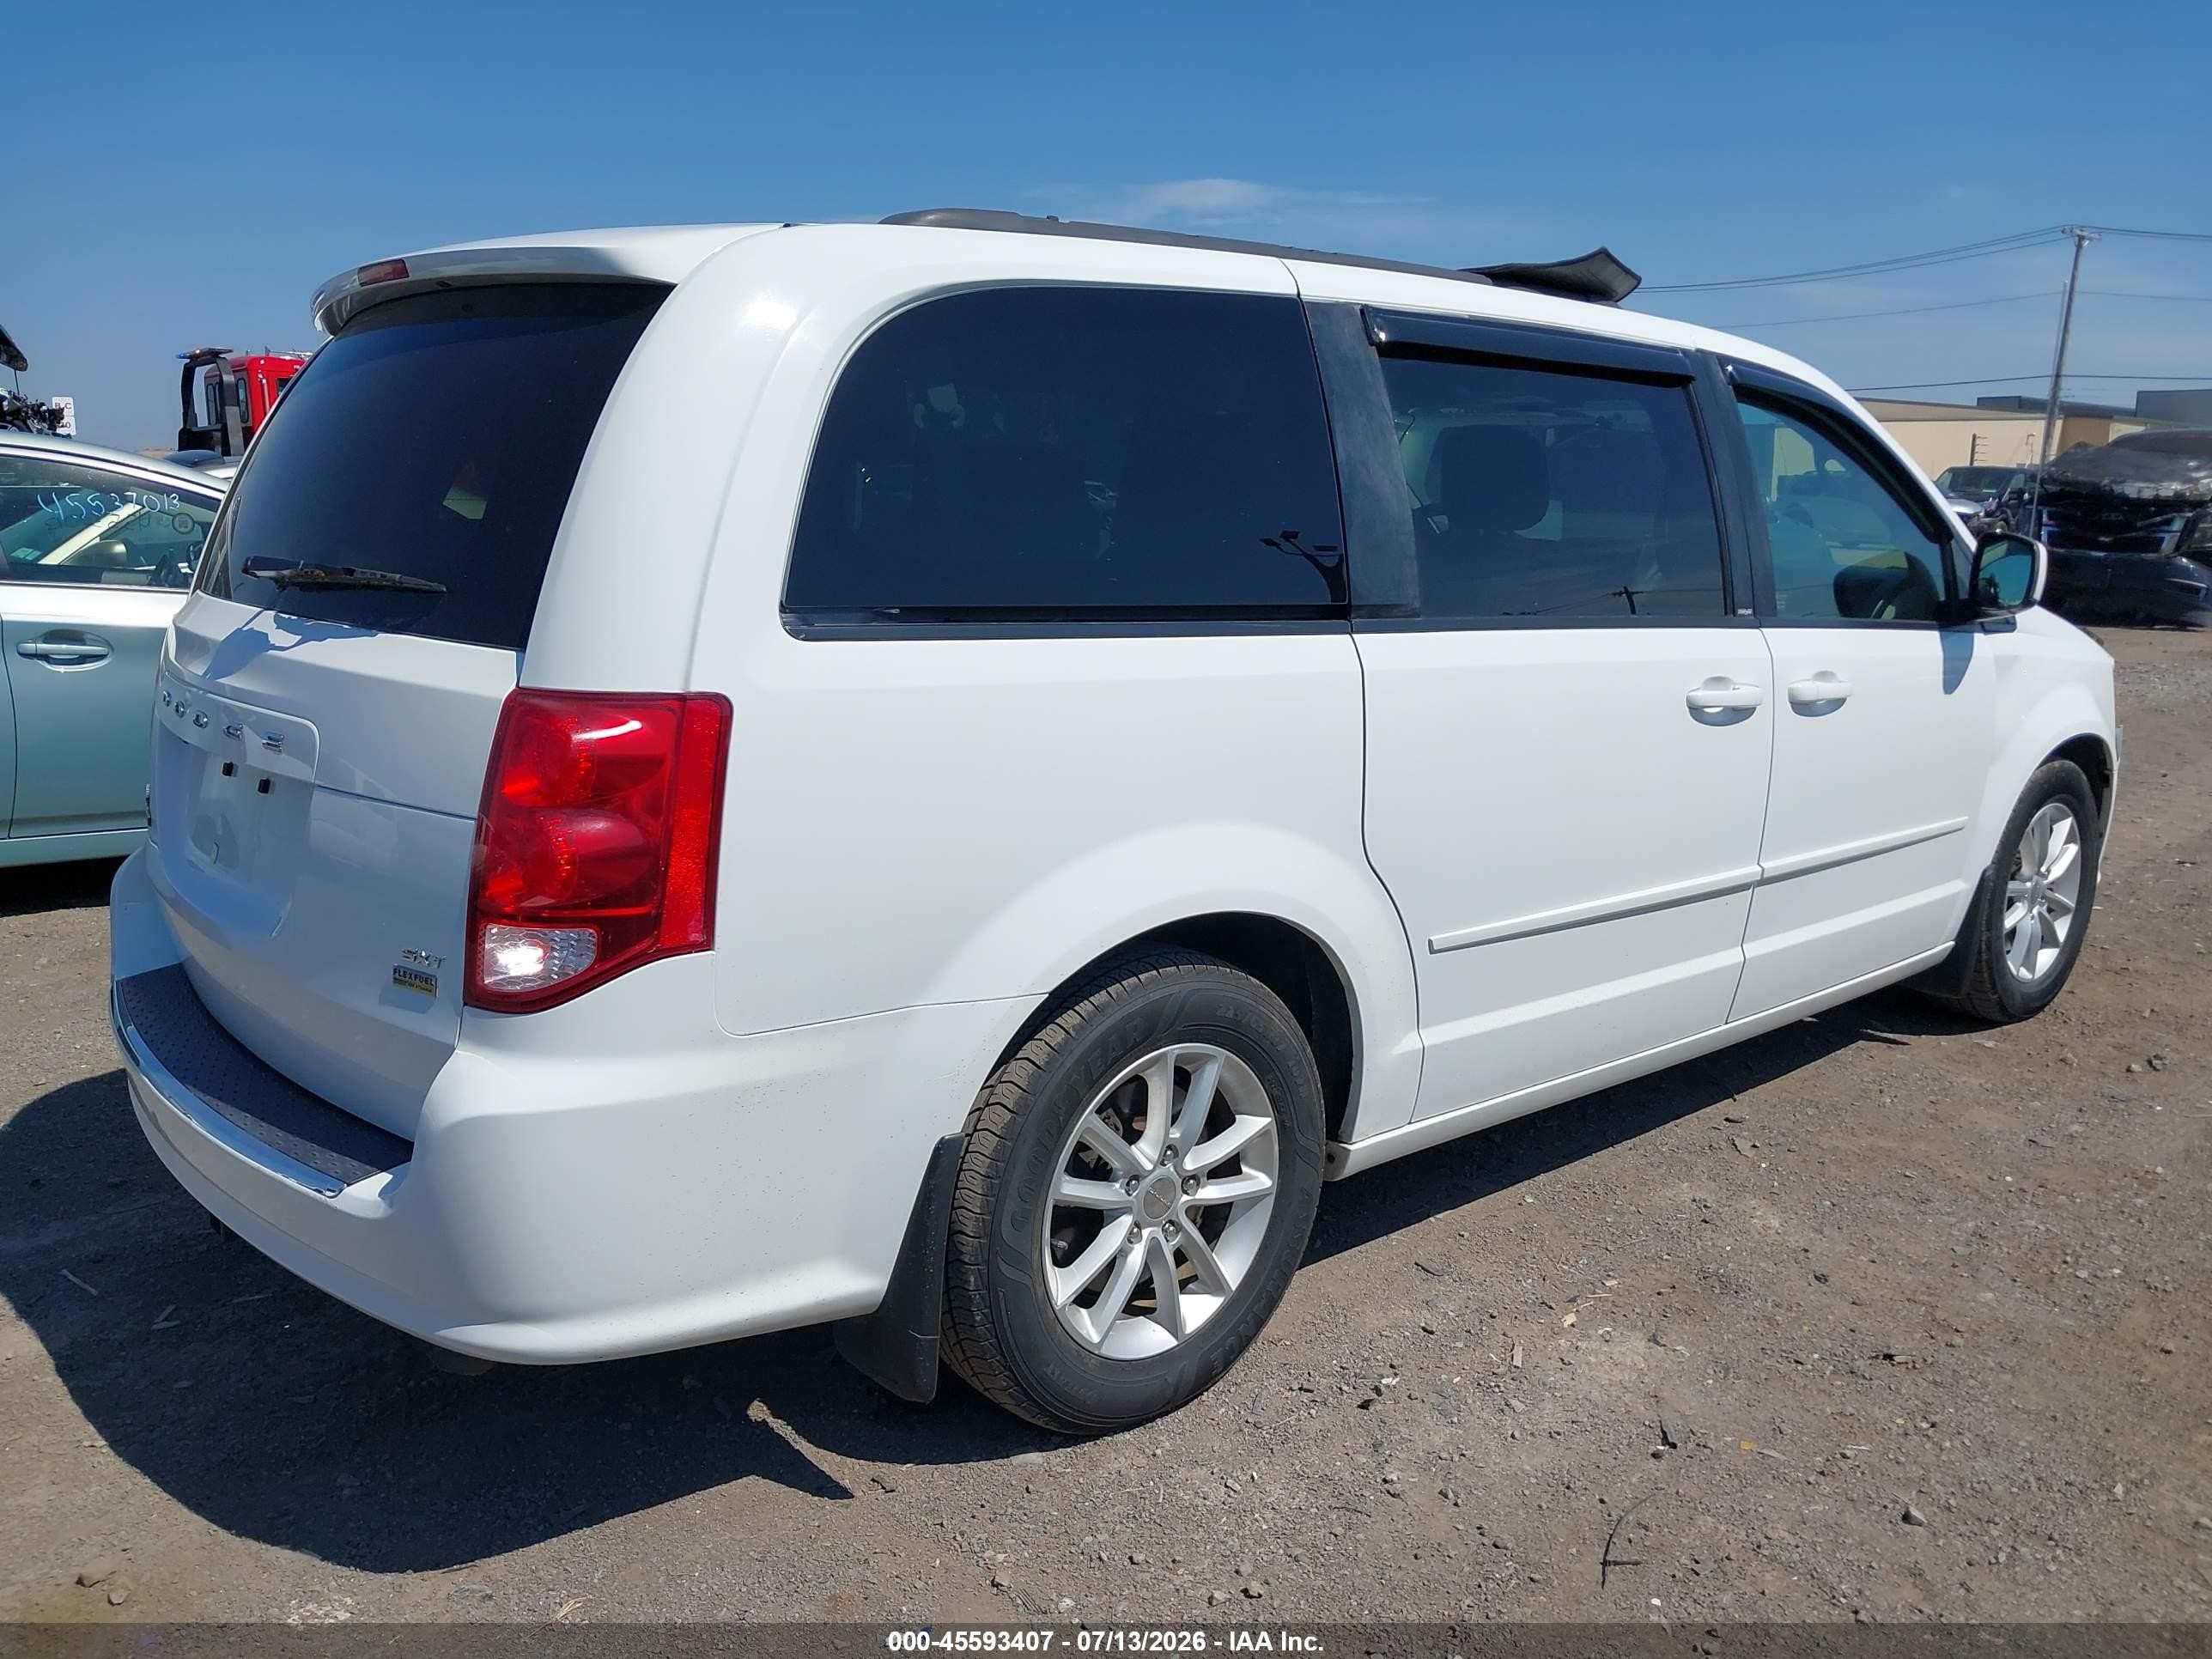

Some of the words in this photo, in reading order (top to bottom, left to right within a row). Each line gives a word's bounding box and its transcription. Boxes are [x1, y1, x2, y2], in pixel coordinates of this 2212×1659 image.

[37, 491, 180, 521] 45537013
[162, 690, 285, 755] DODGE
[401, 948, 447, 969] SXT
[1009, 1014, 1147, 1234] GOODYEAR
